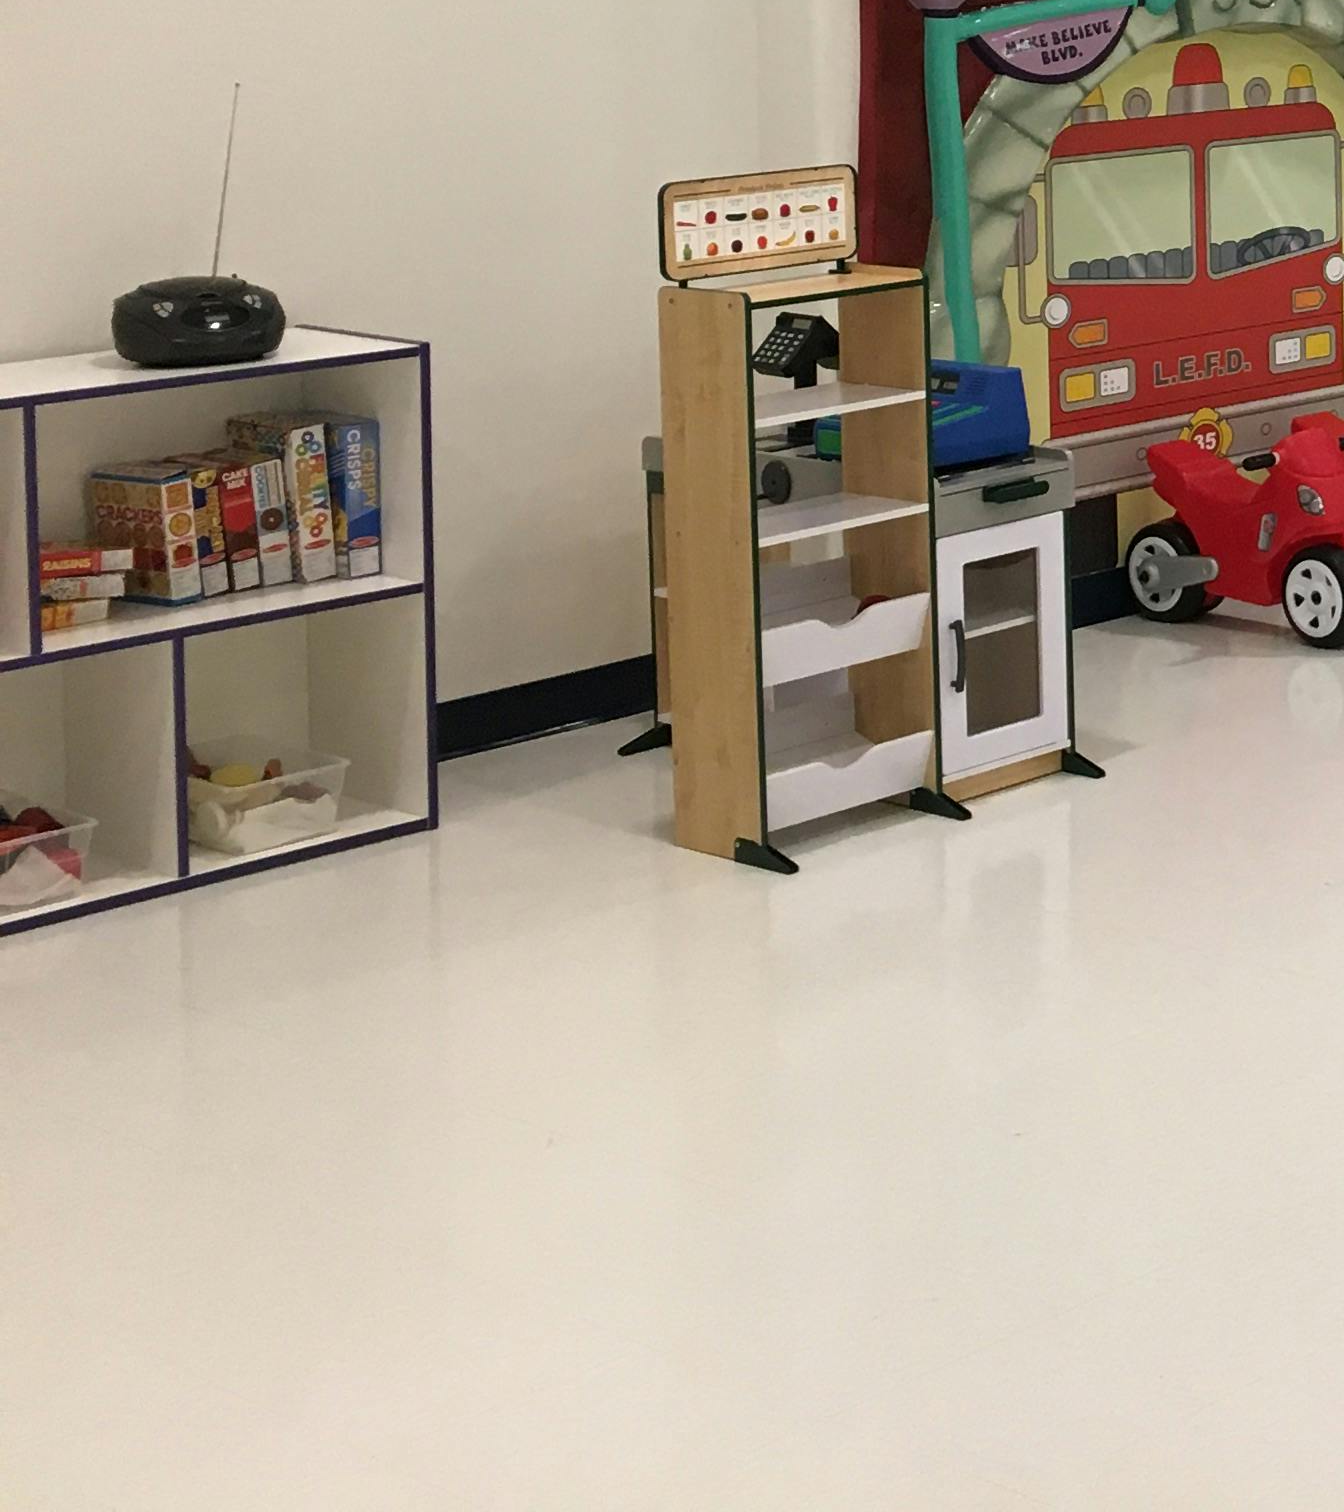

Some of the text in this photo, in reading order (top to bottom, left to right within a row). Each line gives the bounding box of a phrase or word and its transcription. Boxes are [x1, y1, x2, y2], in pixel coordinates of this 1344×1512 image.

[1051, 20, 1112, 45] BELIEVE
[1041, 45, 1083, 65] BLVD.
[1153, 348, 1252, 388] L.E.F.D.
[346, 429, 362, 491] CRISPS
[221, 467, 249, 481] CAKE
[226, 479, 247, 490] MIX
[96, 504, 164, 525] CRACKERS
[41, 558, 92, 572] RAISINS
